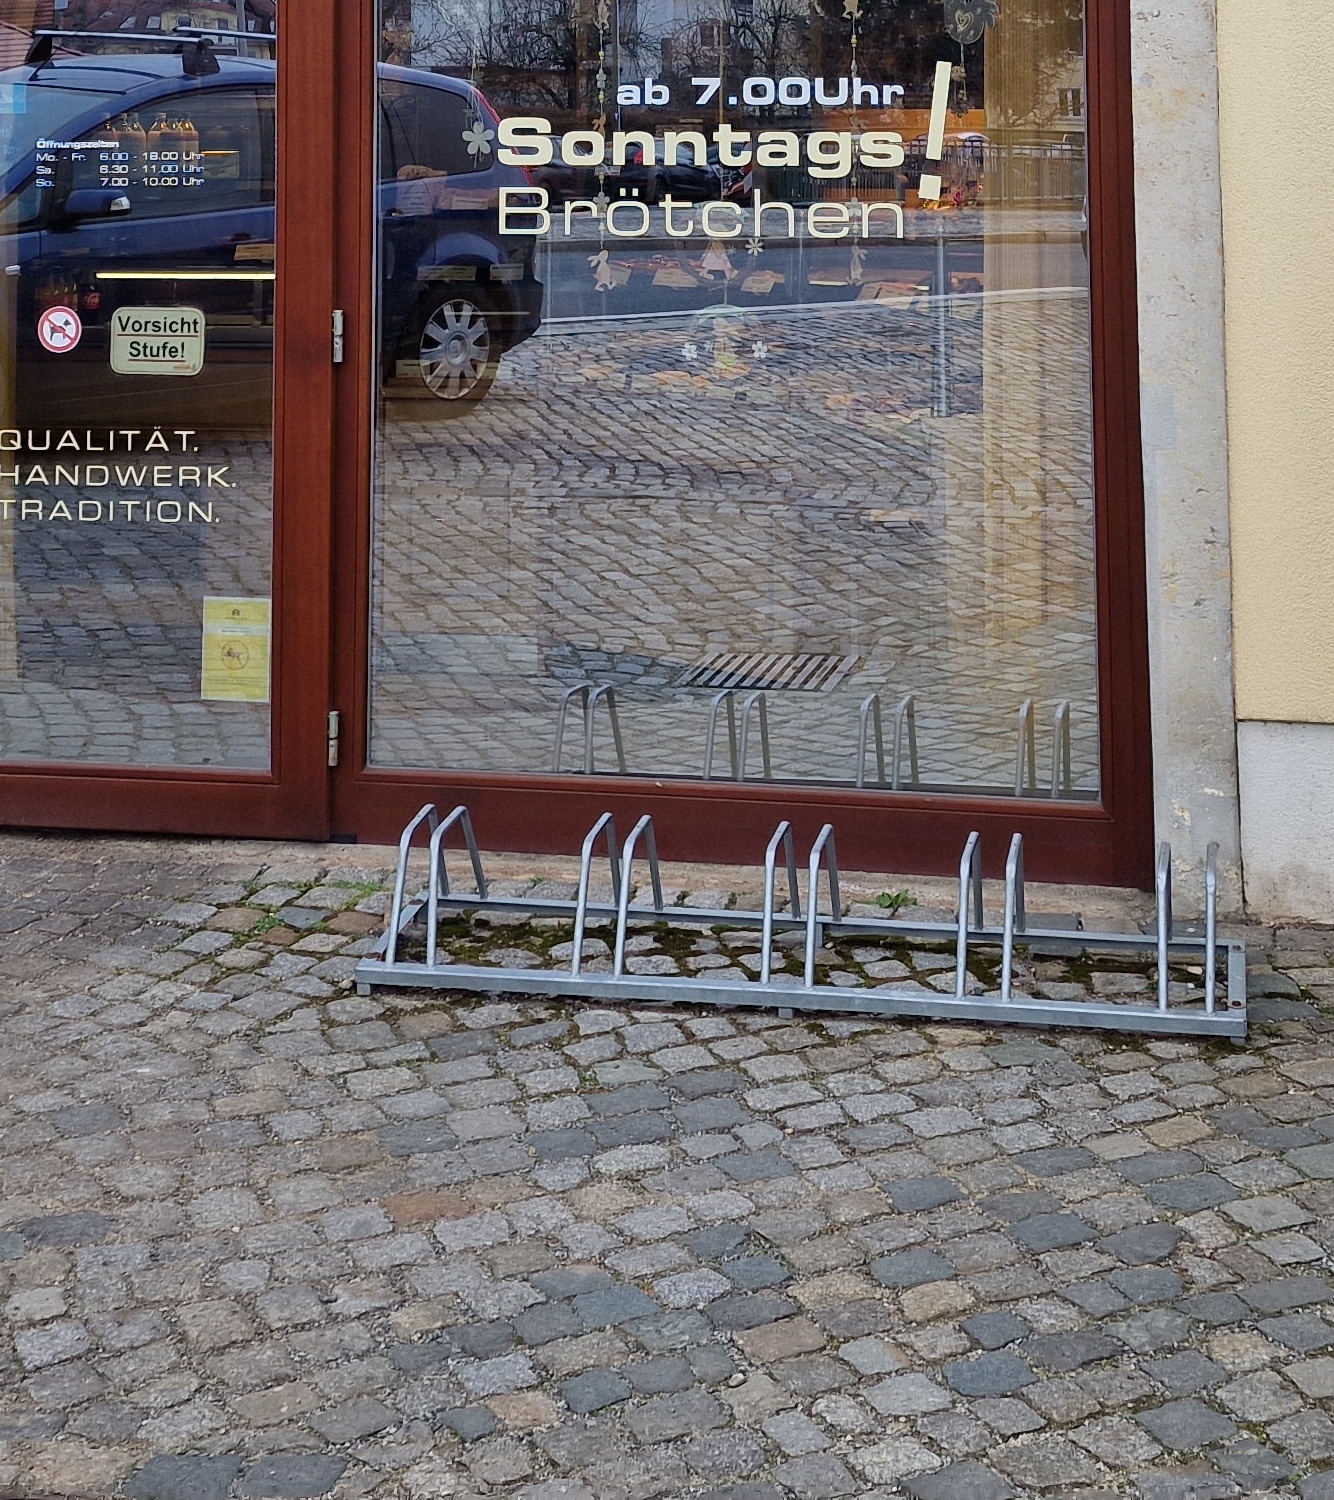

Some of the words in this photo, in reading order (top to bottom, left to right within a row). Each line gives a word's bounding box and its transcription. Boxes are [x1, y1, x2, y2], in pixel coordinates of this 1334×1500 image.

[617, 77, 670, 106] ab
[691, 77, 905, 106] 7.00Uhr
[36, 138, 120, 150] Öffnungszeiten
[497, 117, 906, 179] Sonntags
[36, 152, 59, 162] Mo.
[71, 152, 87, 162] Fr.
[99, 152, 129, 162] 6.00
[142, 152, 179, 162] 18.00
[182, 151, 205, 162] Uhr
[36, 165, 55, 175] Sa.
[99, 164, 129, 174] 6.30
[142, 164, 179, 174] 11.00
[182, 164, 205, 174] Uhr
[35, 178, 56, 187] So.
[99, 177, 129, 187] 7.00
[142, 177, 179, 187] 10.00
[182, 177, 205, 187] Uhr
[497, 186, 905, 239] Brötchen
[117, 315, 199, 334] Vorsicht
[128, 341, 185, 359] Stufe!
